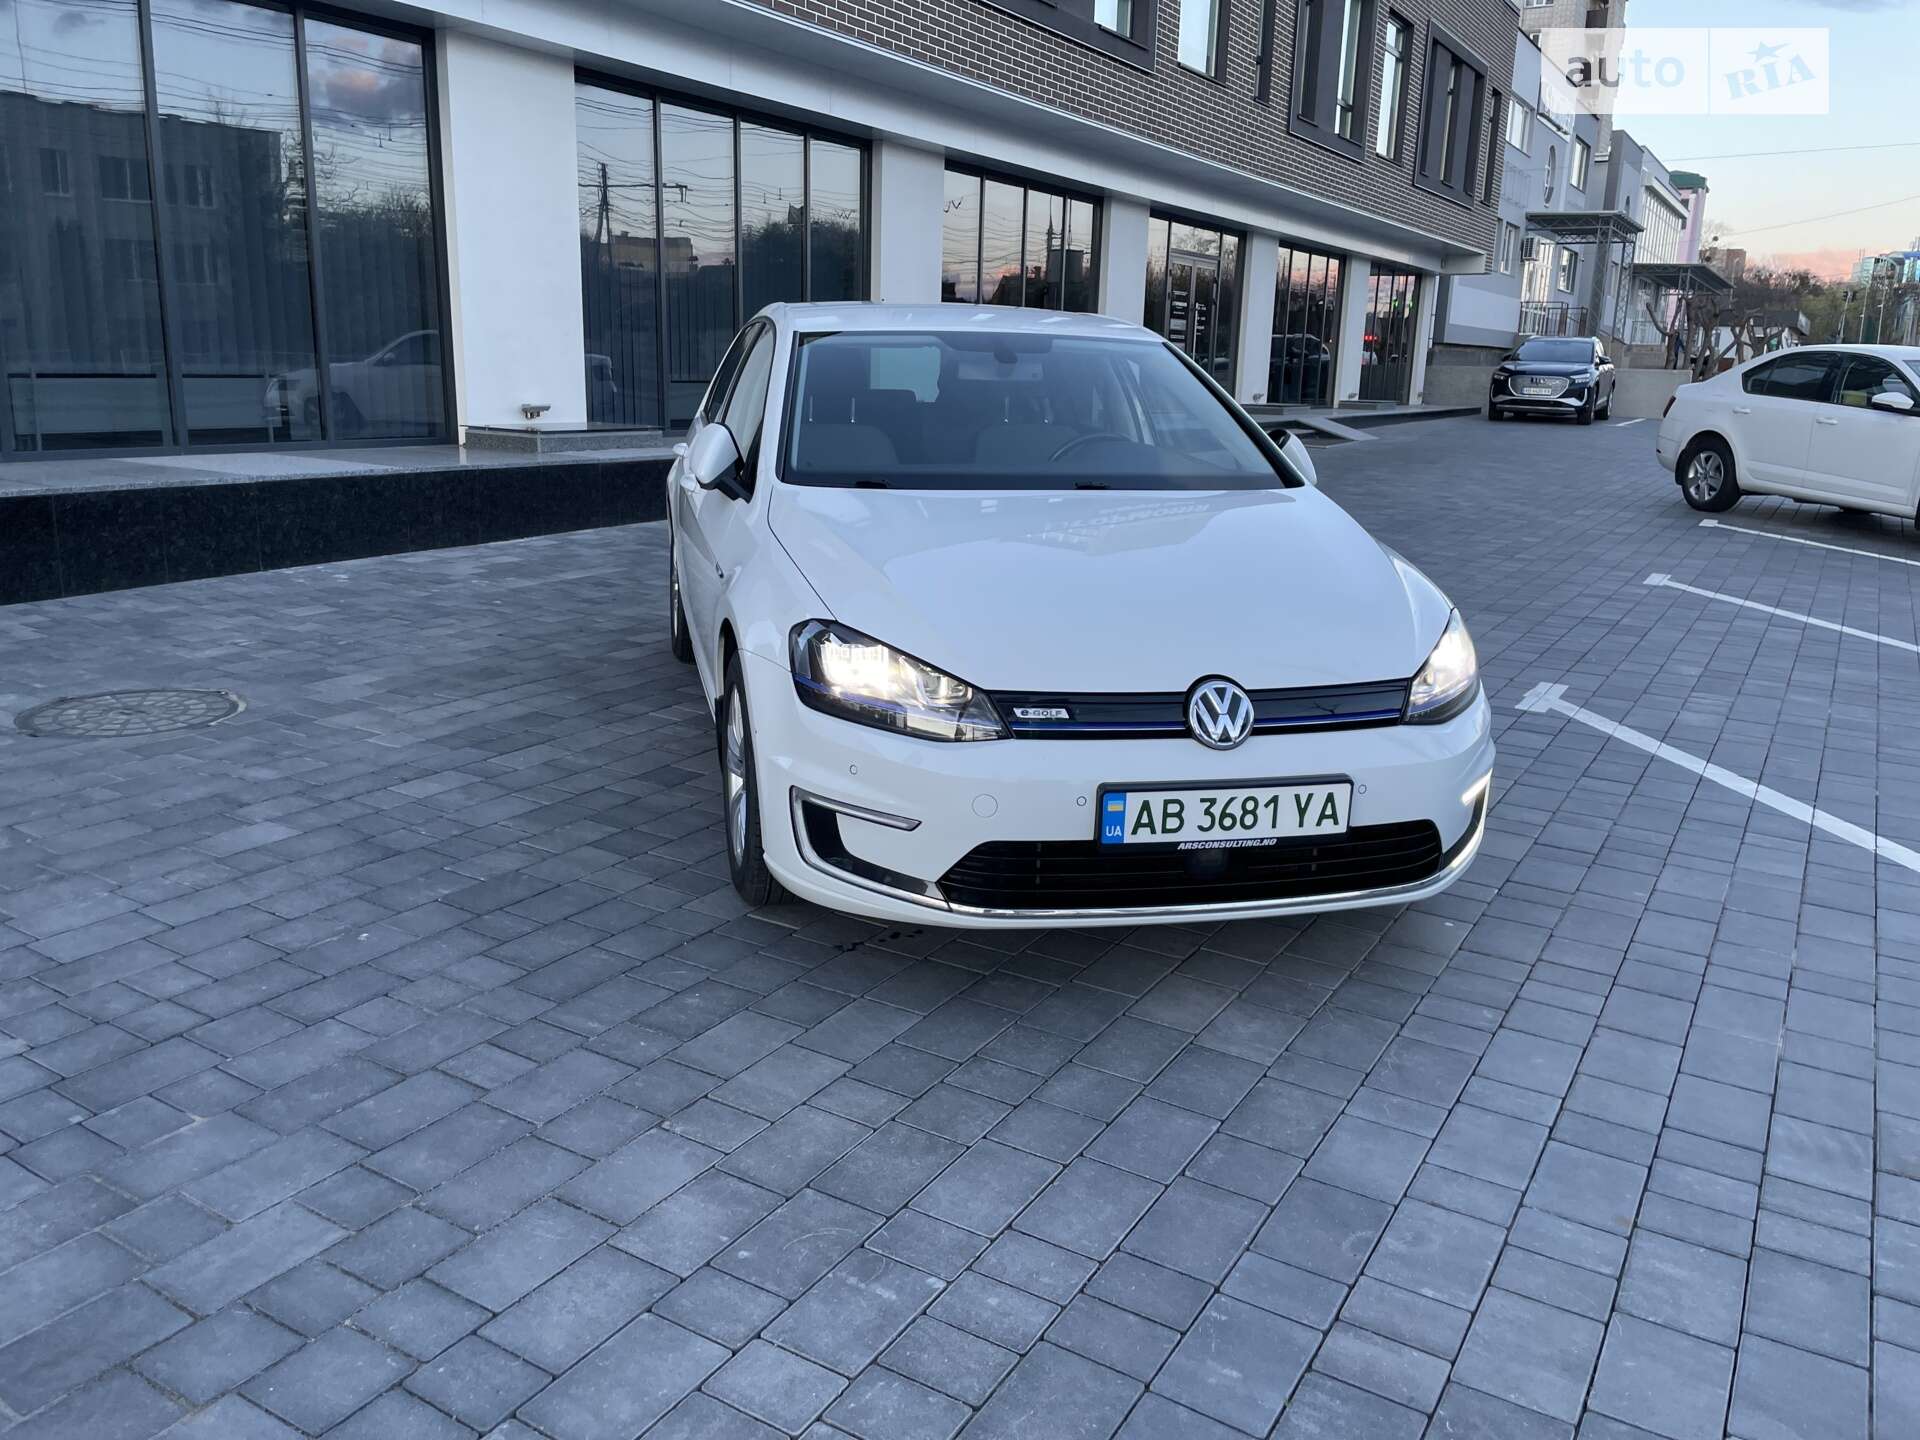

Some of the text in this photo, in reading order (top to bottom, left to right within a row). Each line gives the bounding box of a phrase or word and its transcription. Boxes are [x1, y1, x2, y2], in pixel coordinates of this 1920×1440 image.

[1131, 791, 1340, 836] AB 3681 YA
[1106, 826, 1123, 837] UA
[1177, 838, 1278, 850] ARSCONSULTING.NO
